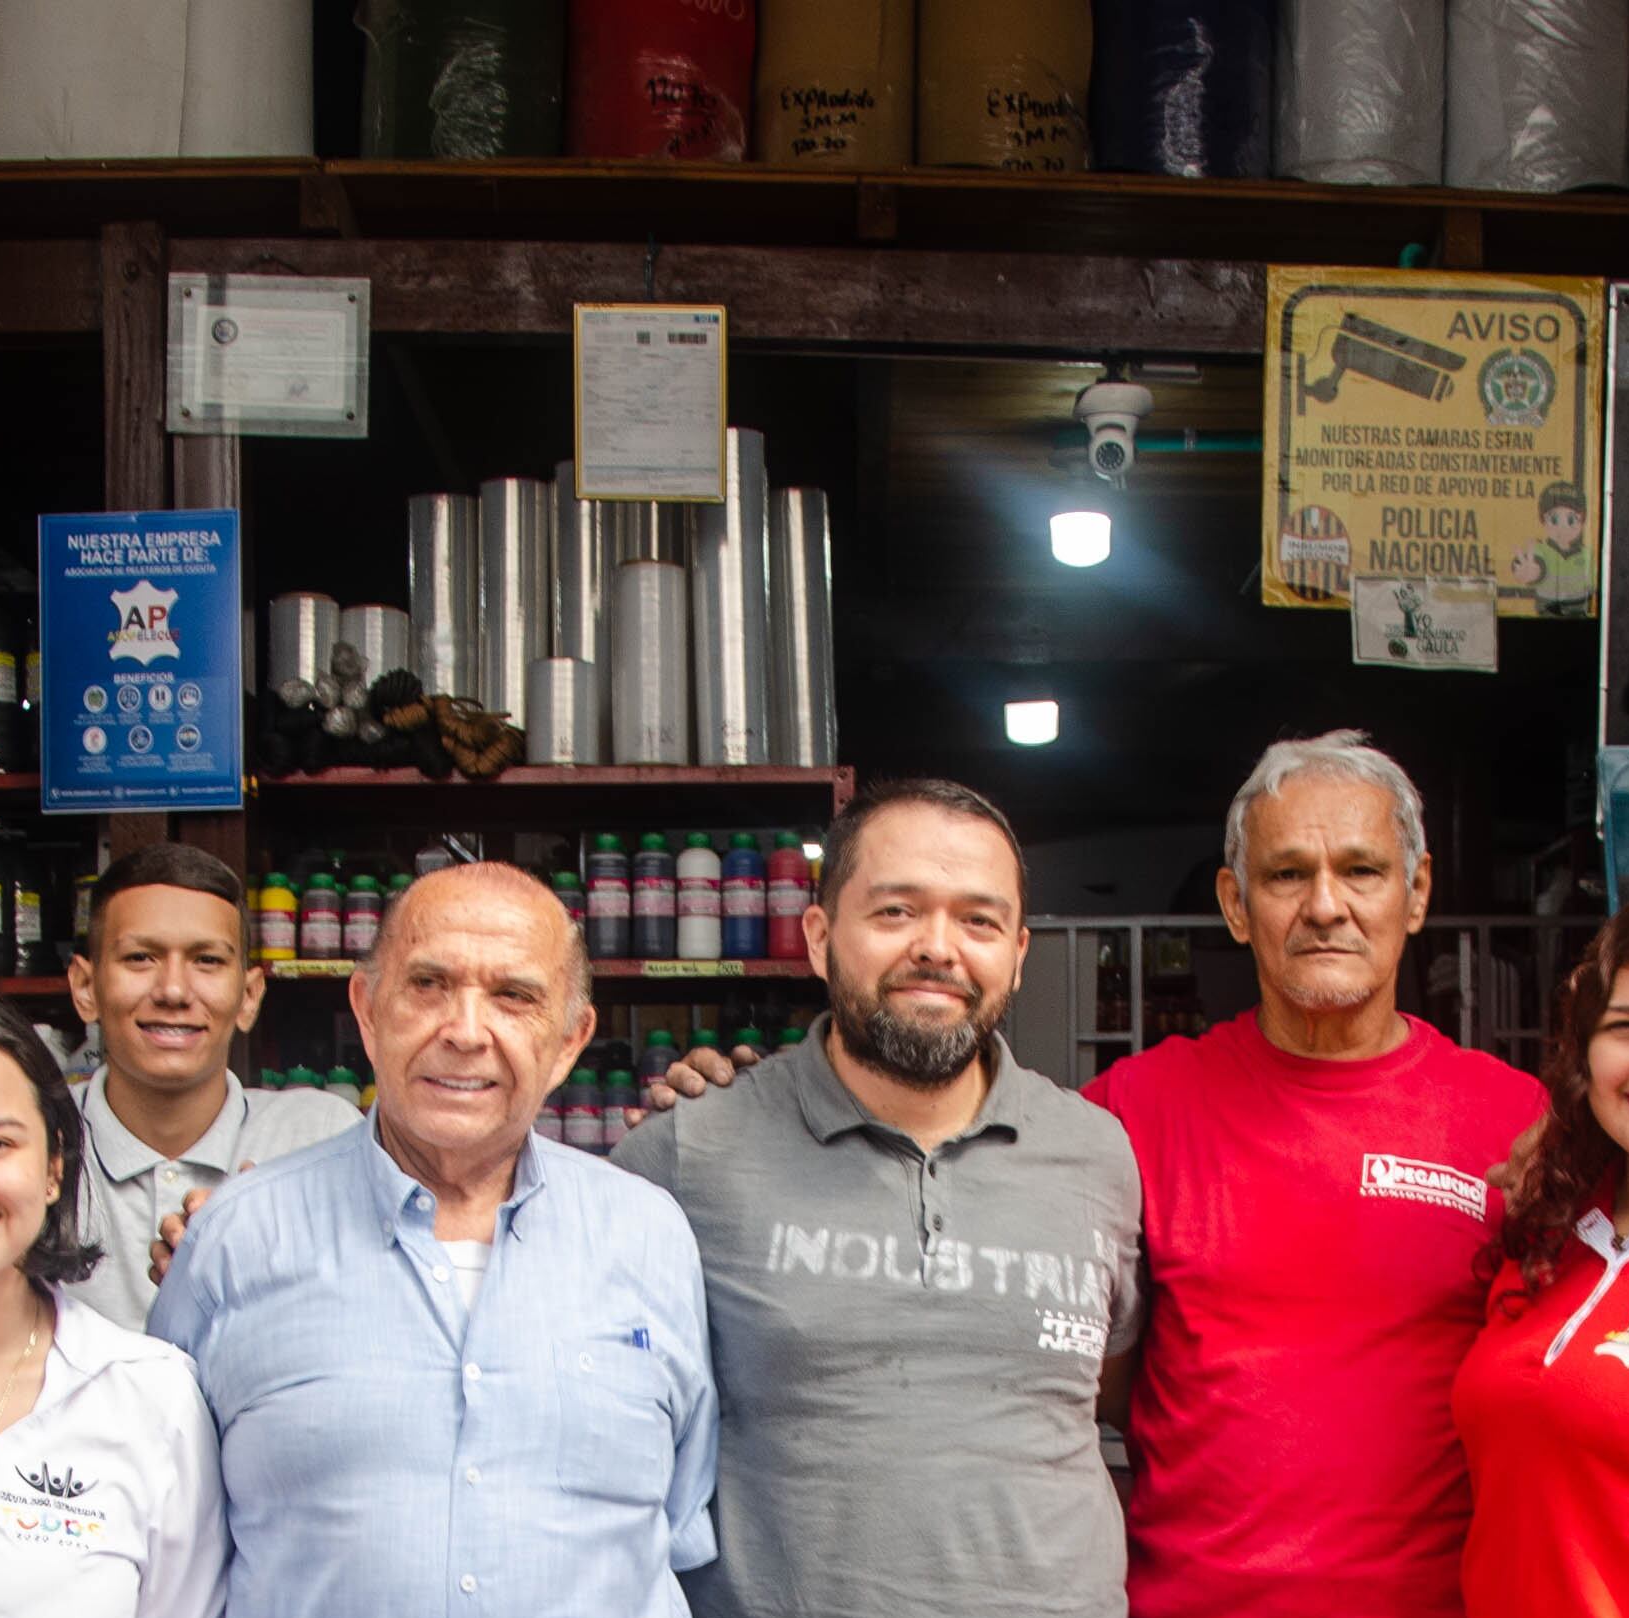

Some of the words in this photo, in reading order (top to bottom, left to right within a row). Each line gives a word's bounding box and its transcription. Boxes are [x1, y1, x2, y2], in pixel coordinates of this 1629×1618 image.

[1446, 310, 1562, 345] AVISO
[1321, 424, 1402, 448] NUESTRAS
[1405, 426, 1481, 450] CAMARAS
[1485, 428, 1535, 451] ESTAN
[1296, 447, 1416, 471] MONITOREADAS
[1419, 450, 1563, 476] CONSTANTEMENTE
[1321, 473, 1352, 494] POR
[1355, 474, 1376, 495] LA
[1380, 475, 1410, 496] RED
[1414, 477, 1434, 497] DE
[1438, 476, 1488, 499] APOYO
[1492, 478, 1512, 499] DE
[1515, 480, 1536, 500] LA
[1381, 506, 1479, 540] POLICIA
[67, 533, 141, 550] NUESTRA
[145, 530, 221, 548] EMPRESA
[80, 548, 123, 565] HACE
[127, 547, 180, 564] PARTE
[182, 547, 210, 563] DE:
[1369, 540, 1496, 577] NACIONAL
[123, 605, 168, 630] AP
